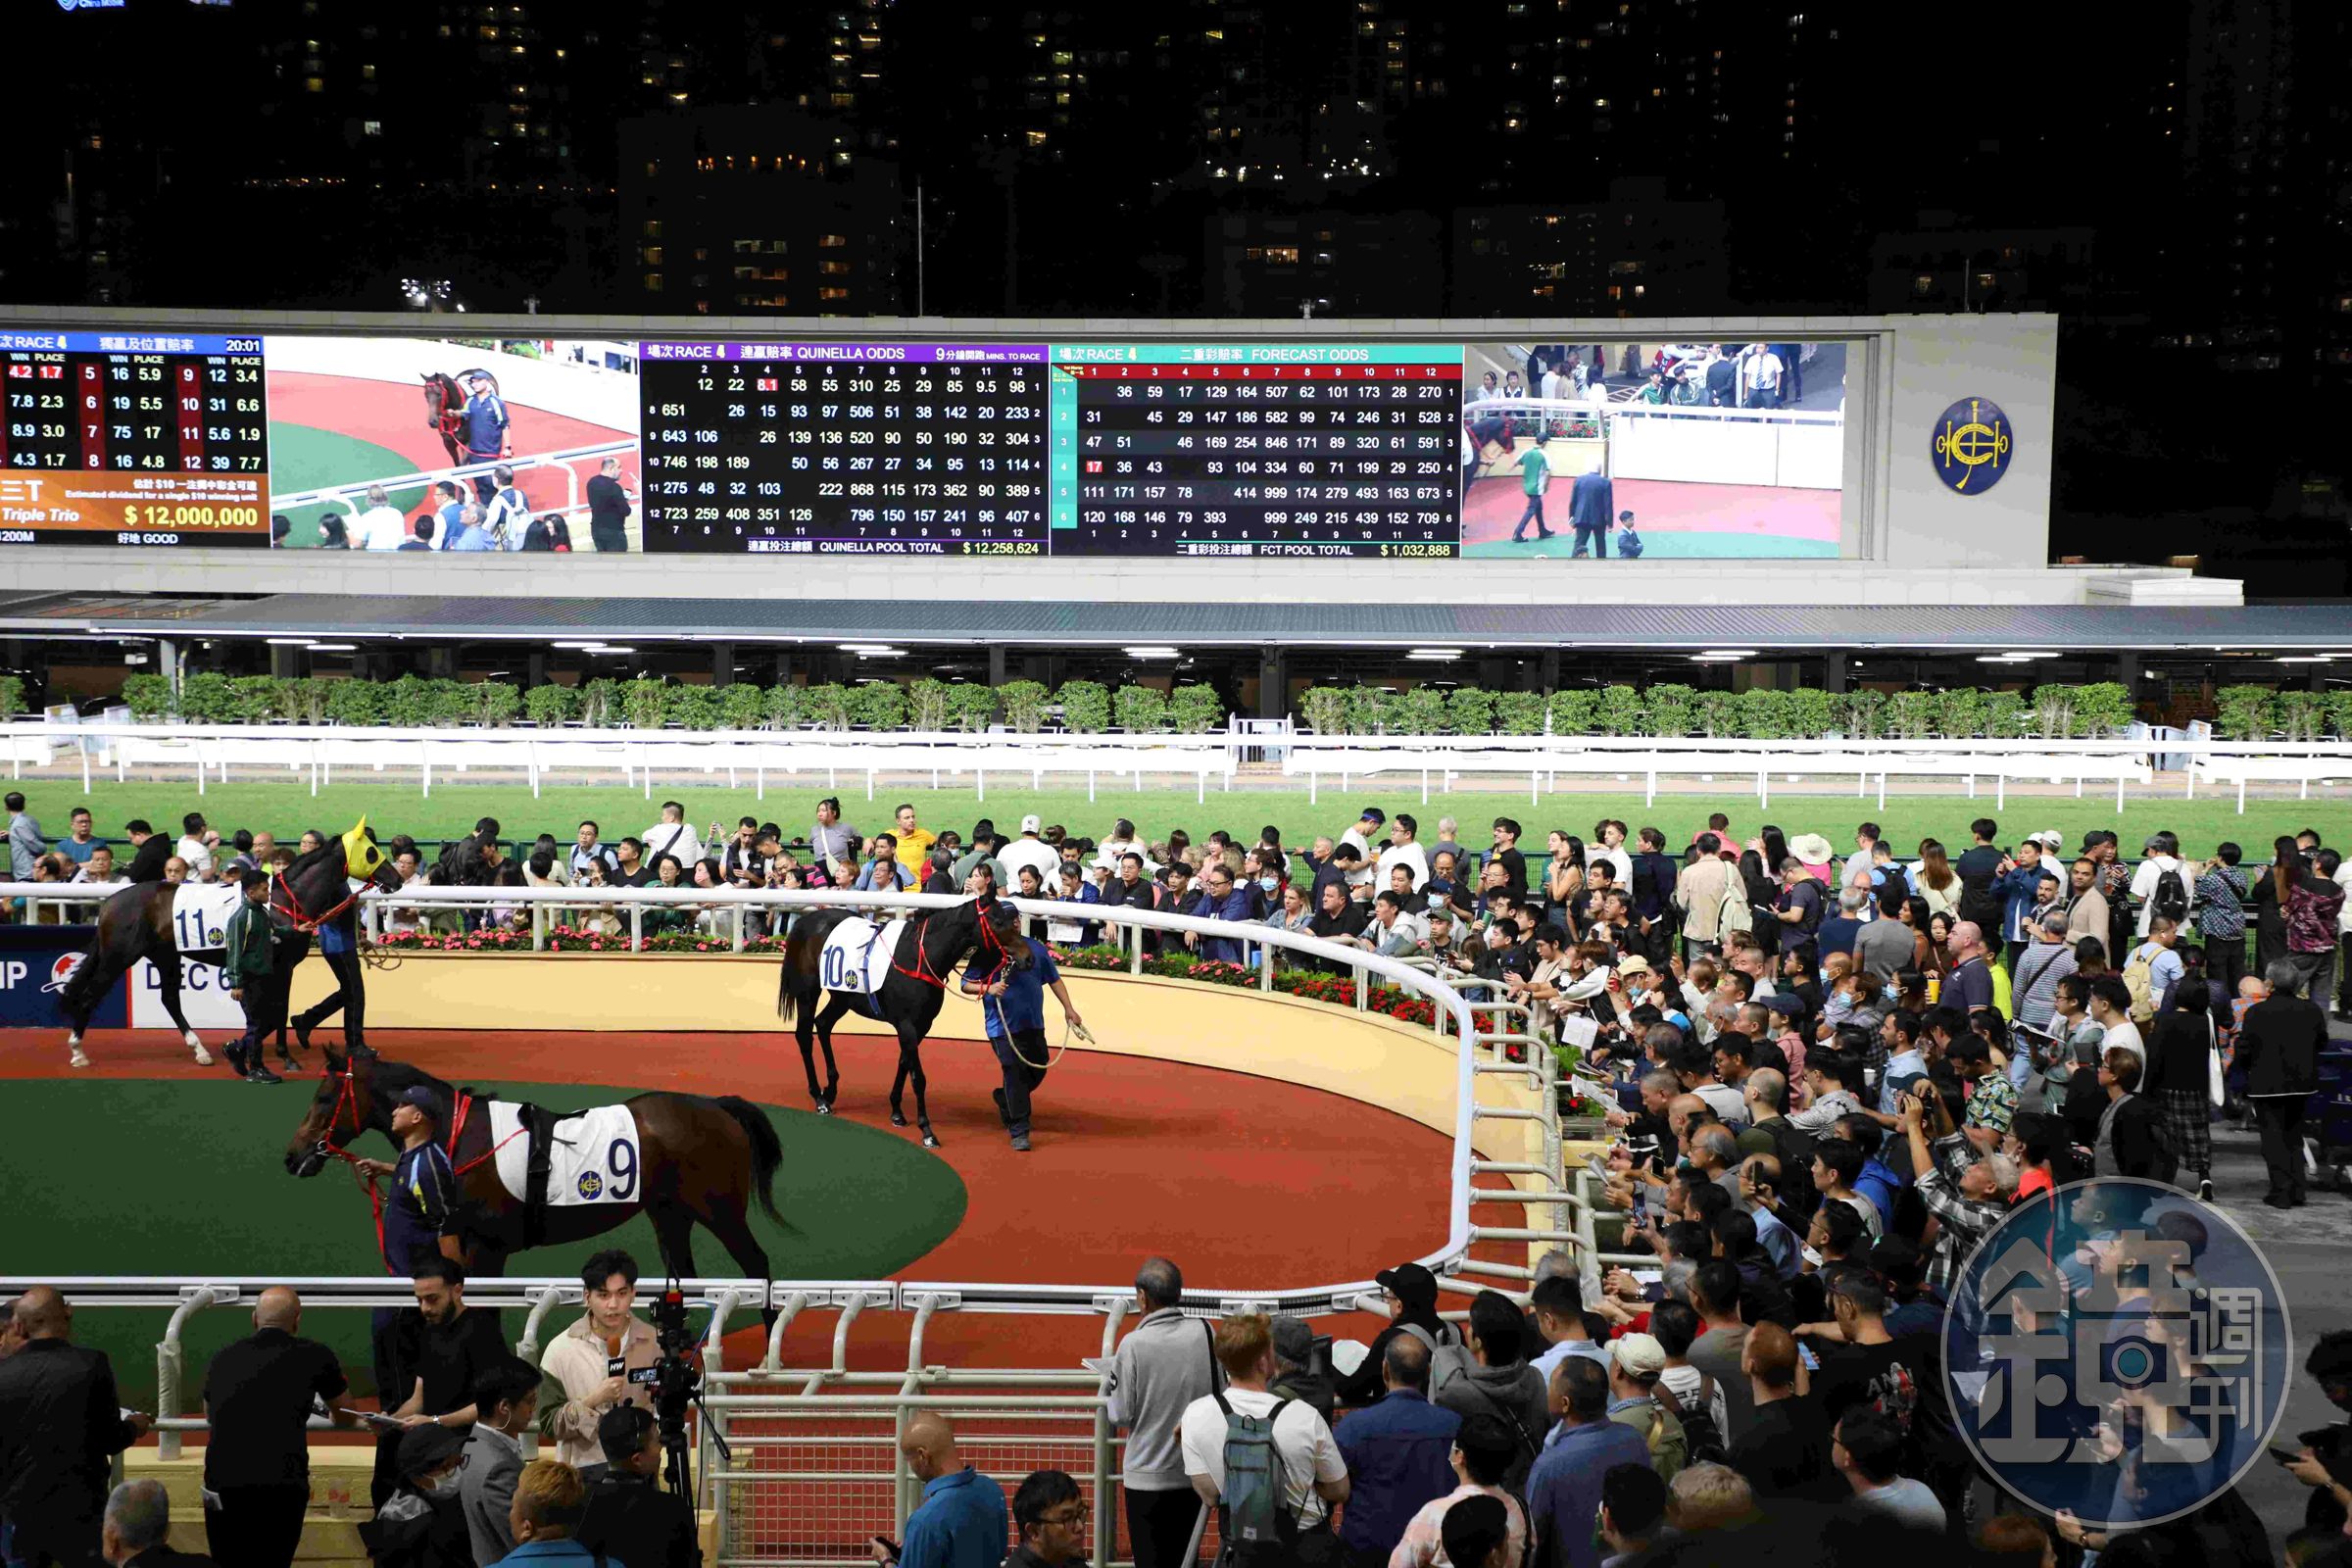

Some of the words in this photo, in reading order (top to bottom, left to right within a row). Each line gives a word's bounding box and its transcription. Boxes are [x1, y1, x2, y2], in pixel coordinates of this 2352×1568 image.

[16, 336, 54, 348] RACE
[57, 335, 67, 349] 4
[226, 340, 259, 351] 20:01
[675, 346, 711, 358] RACE
[716, 345, 725, 358] 4
[798, 347, 863, 359] QUINELLA
[866, 348, 905, 359] ODDS
[1087, 349, 1123, 361] RACE
[1128, 347, 1137, 361] 4
[1251, 349, 1325, 361] FORECAST
[1329, 349, 1369, 362] ODDS
[134, 355, 164, 364] PLACE
[231, 357, 261, 366] PLACE
[9, 366, 31, 378] 4.2
[40, 367, 62, 378] 1.7
[85, 367, 95, 379] 5
[112, 368, 128, 380] 16
[139, 368, 161, 380] 5.9
[184, 368, 193, 381] 9
[210, 369, 226, 381] 12
[236, 369, 258, 382] 3.4
[698, 378, 712, 390] 12
[728, 379, 744, 390] 22
[758, 379, 776, 391] 8.1
[791, 379, 807, 391] 58
[822, 379, 838, 391] 55
[850, 380, 873, 391] 310
[885, 380, 901, 392] 25
[916, 380, 932, 392] 29
[947, 380, 962, 392] 85
[976, 381, 996, 392] 9.5
[1009, 381, 1025, 392] 98
[1117, 386, 1132, 397] 36
[1148, 386, 1162, 397] 59
[1179, 386, 1193, 397] 17
[1205, 386, 1227, 397] 129
[1237, 386, 1257, 397] 164
[1266, 386, 1288, 397] 507
[1299, 386, 1314, 397] 62
[1328, 386, 1348, 397] 101
[1358, 386, 1380, 397] 173
[1392, 386, 1406, 398] 28
[1419, 386, 1442, 398] 270
[11, 395, 33, 407] 7.8
[41, 395, 64, 408] 2.3
[86, 396, 96, 409] 6
[113, 397, 129, 409] 19
[140, 397, 162, 410] 5.5
[182, 398, 198, 411] 10
[210, 398, 225, 411] 31
[237, 399, 259, 412] 6.6
[13, 424, 34, 436] 8.9
[43, 424, 65, 437] 3.0
[88, 425, 97, 437] 7
[114, 426, 131, 438] 75
[144, 426, 161, 438] 17
[183, 427, 198, 439] 11
[209, 427, 230, 440] 5.6
[239, 428, 260, 440] 1.9
[14, 454, 36, 466] 4.3
[45, 454, 66, 466] 1.7
[89, 455, 99, 466] 8
[116, 455, 132, 467] 16
[142, 456, 165, 467] 4.8
[184, 456, 201, 468] 12
[212, 457, 229, 468] 39
[239, 457, 261, 469] 7.7
[663, 456, 687, 467] 746
[696, 457, 718, 468] 198
[727, 457, 749, 468] 189
[792, 458, 808, 468] 50
[823, 458, 839, 469] 56
[851, 458, 873, 469] 267
[885, 458, 901, 469] 27
[916, 459, 932, 469] 34
[948, 459, 963, 470] 95
[980, 459, 994, 470] 13
[1006, 459, 1029, 470] 114
[1088, 462, 1102, 472] 17
[1117, 462, 1132, 472] 36
[1147, 462, 1162, 472] 43
[1208, 462, 1223, 472] 93
[1236, 463, 1256, 472] 104
[1265, 463, 1287, 473] 334
[1299, 463, 1314, 473] 60
[1330, 463, 1343, 472] 71
[1357, 463, 1379, 473] 199
[1391, 463, 1405, 473] 29
[1418, 463, 1440, 473] 250
[2, 508, 46, 523] Triple
[49, 509, 79, 521] Trio
[125, 506, 137, 525] $
[145, 507, 257, 528] 12,000,000
[1084, 512, 1105, 522] 120
[1114, 512, 1135, 522] 168
[1145, 512, 1165, 522] 146
[1178, 512, 1192, 522] 79
[1204, 513, 1226, 523] 393
[1264, 513, 1287, 523] 999
[143, 534, 177, 544] GOOD
[819, 542, 874, 553] QUINELLA
[876, 543, 906, 553] POOL
[908, 543, 944, 553] TOTAL
[974, 543, 1039, 555] 12,258,624
[1260, 545, 1282, 555] FCT
[1285, 546, 1315, 556] POOL
[1318, 546, 1353, 556] TOTAL
[1393, 545, 1450, 556] 1,032,888
[175, 907, 206, 949] 11
[822, 945, 845, 988] 10
[608, 1138, 637, 1200] 9
